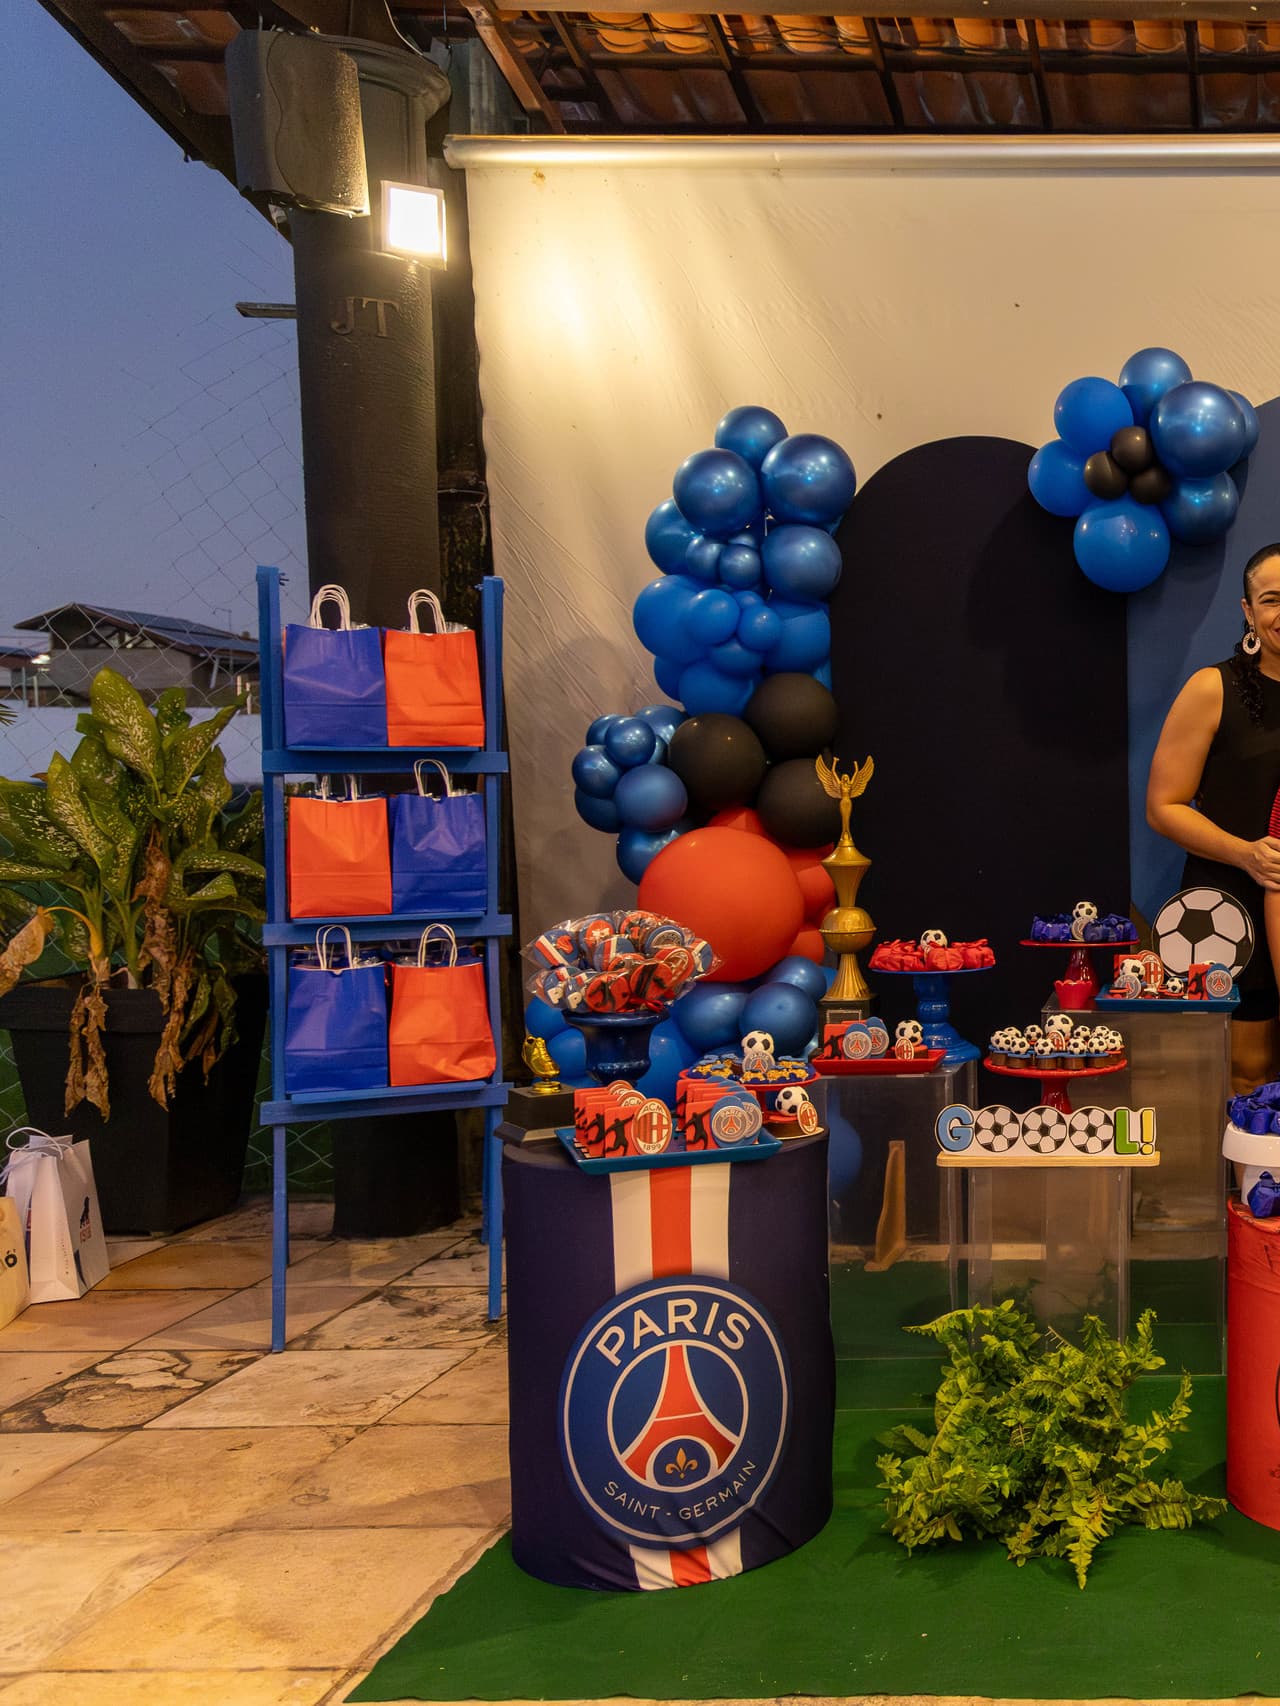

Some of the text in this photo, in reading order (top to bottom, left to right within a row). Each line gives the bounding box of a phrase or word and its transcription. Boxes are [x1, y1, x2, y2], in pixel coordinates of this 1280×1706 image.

[330, 296, 401, 337] JT
[642, 1102, 664, 1113] ACM
[595, 1298, 751, 1367] PARIS
[604, 1481, 660, 1520] SAINT
[678, 1460, 757, 1520] GERMAIN
